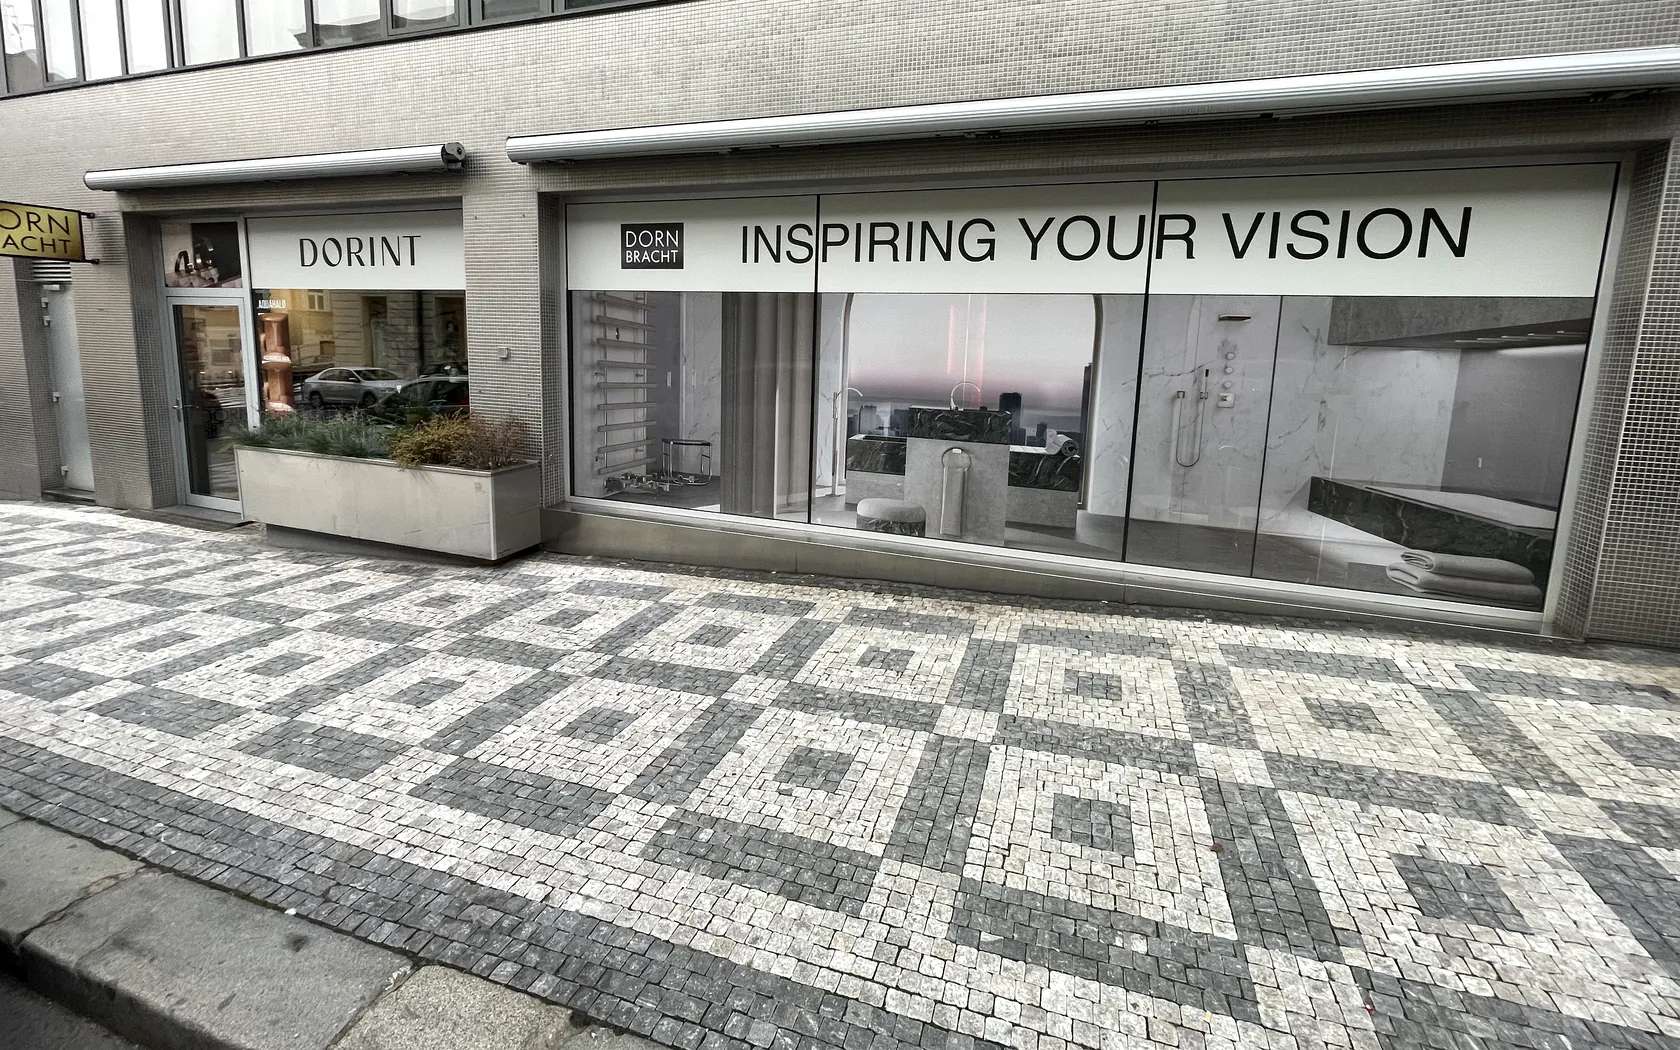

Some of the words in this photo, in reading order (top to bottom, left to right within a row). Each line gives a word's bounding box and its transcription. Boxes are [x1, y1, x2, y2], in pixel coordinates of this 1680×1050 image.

[0, 209, 70, 235] ORN
[742, 218, 996, 264] INSPIRING
[1018, 213, 1197, 262] YOUR
[1221, 206, 1473, 260] VISION
[299, 235, 421, 268] DORINT
[625, 229, 679, 248] DORN
[625, 249, 679, 263] BRACHT
